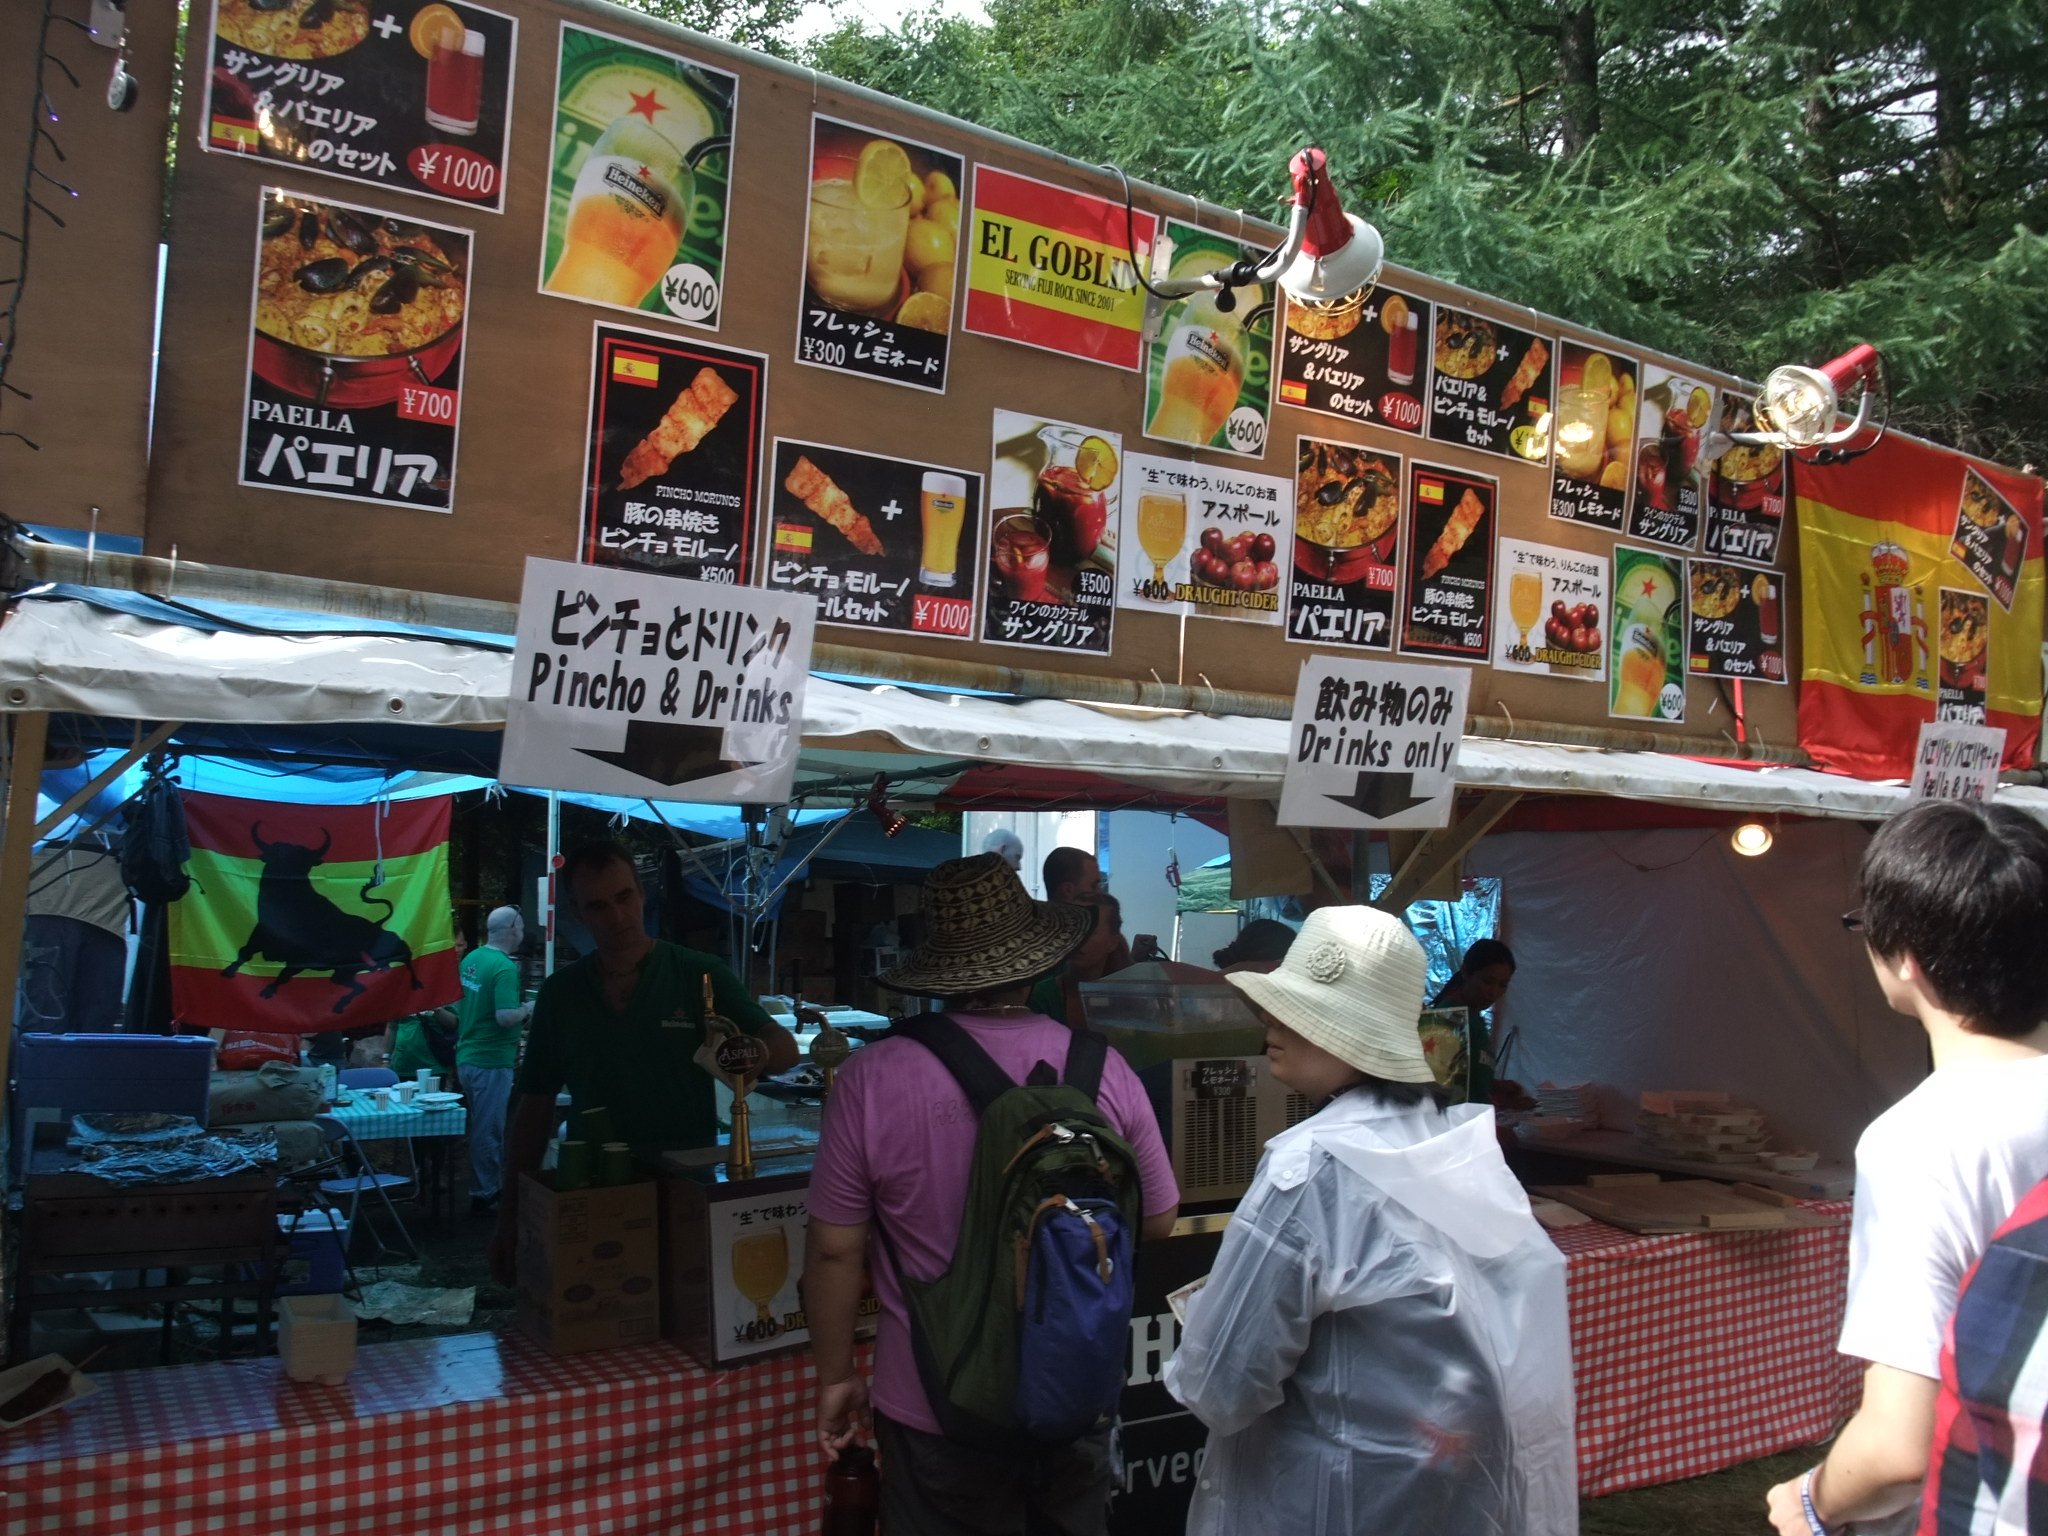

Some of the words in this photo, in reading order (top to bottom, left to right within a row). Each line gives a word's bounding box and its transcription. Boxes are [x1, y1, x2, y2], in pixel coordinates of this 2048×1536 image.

[223, 48, 344, 96] サングリア
[307, 138, 398, 178] のセット
[416, 147, 496, 196] ¥1000
[608, 167, 665, 217] Heineken
[980, 219, 1018, 264] EL
[1028, 234, 1144, 297] GOBLIN
[665, 275, 714, 311] ¥600
[1005, 268, 1037, 292] SERVING
[1037, 277, 1054, 296] FUJI
[1054, 283, 1074, 302] ROCK
[1075, 287, 1097, 309] SINCE
[1096, 294, 1115, 312] 2001
[808, 309, 896, 344] フレッシュ
[803, 336, 846, 366] ¥300
[854, 342, 940, 375] レモネード
[1288, 335, 1349, 363] サングリア
[251, 399, 355, 434] PAELLA
[404, 388, 452, 419] ¥700
[1329, 392, 1374, 417] のセット
[1382, 395, 1420, 425] ¥1000
[1228, 418, 1262, 444] ¥600
[1465, 425, 1493, 446] セット
[257, 433, 438, 498] パエリア
[656, 485, 693, 502] PINCHO
[694, 489, 742, 507] MORUNOS
[1555, 478, 1600, 501] フレッシュ
[623, 501, 720, 535] 豚の串焼き
[1202, 500, 1281, 527] アスポール
[1552, 500, 1575, 518] ¥300
[1578, 500, 1622, 521] レモネード
[1709, 505, 1748, 523] PELLA
[1638, 518, 1689, 543] サングリア
[1708, 524, 1774, 557] パエリア
[701, 565, 735, 586] ¥500
[1080, 571, 1111, 594] ¥500
[1368, 566, 1394, 588] ¥700
[1076, 593, 1112, 607] SANGRIA
[1133, 578, 1169, 601] ¥600
[1175, 582, 1237, 606] DRAUGHT
[1240, 590, 1279, 611] CIDER
[1293, 582, 1345, 602] PAELLA
[1424, 587, 1475, 610] 豚の串焼き
[915, 600, 970, 631] ¥1000
[1009, 600, 1089, 623] ワインのカクテル
[1294, 604, 1386, 643] パエリア
[551, 589, 792, 670] ピンチョとドリンク
[1002, 616, 1095, 645] サングリア
[1463, 632, 1482, 647] ¥500
[1694, 618, 1734, 635] サングリア
[1535, 647, 1578, 666] DRAUGHT
[1579, 652, 1602, 670] CIDER
[1723, 658, 1755, 674] のセット
[528, 652, 646, 713] Pincho
[659, 667, 681, 717] &
[691, 669, 793, 725] Drinks
[1314, 675, 1454, 727] 飲み物のみ
[1298, 723, 1393, 767] Drinks
[1404, 731, 1455, 773] only
[1201, 1066, 1239, 1076] フレッシュ
[1201, 1075, 1240, 1085] レモネード
[734, 1316, 777, 1343] ¥600
